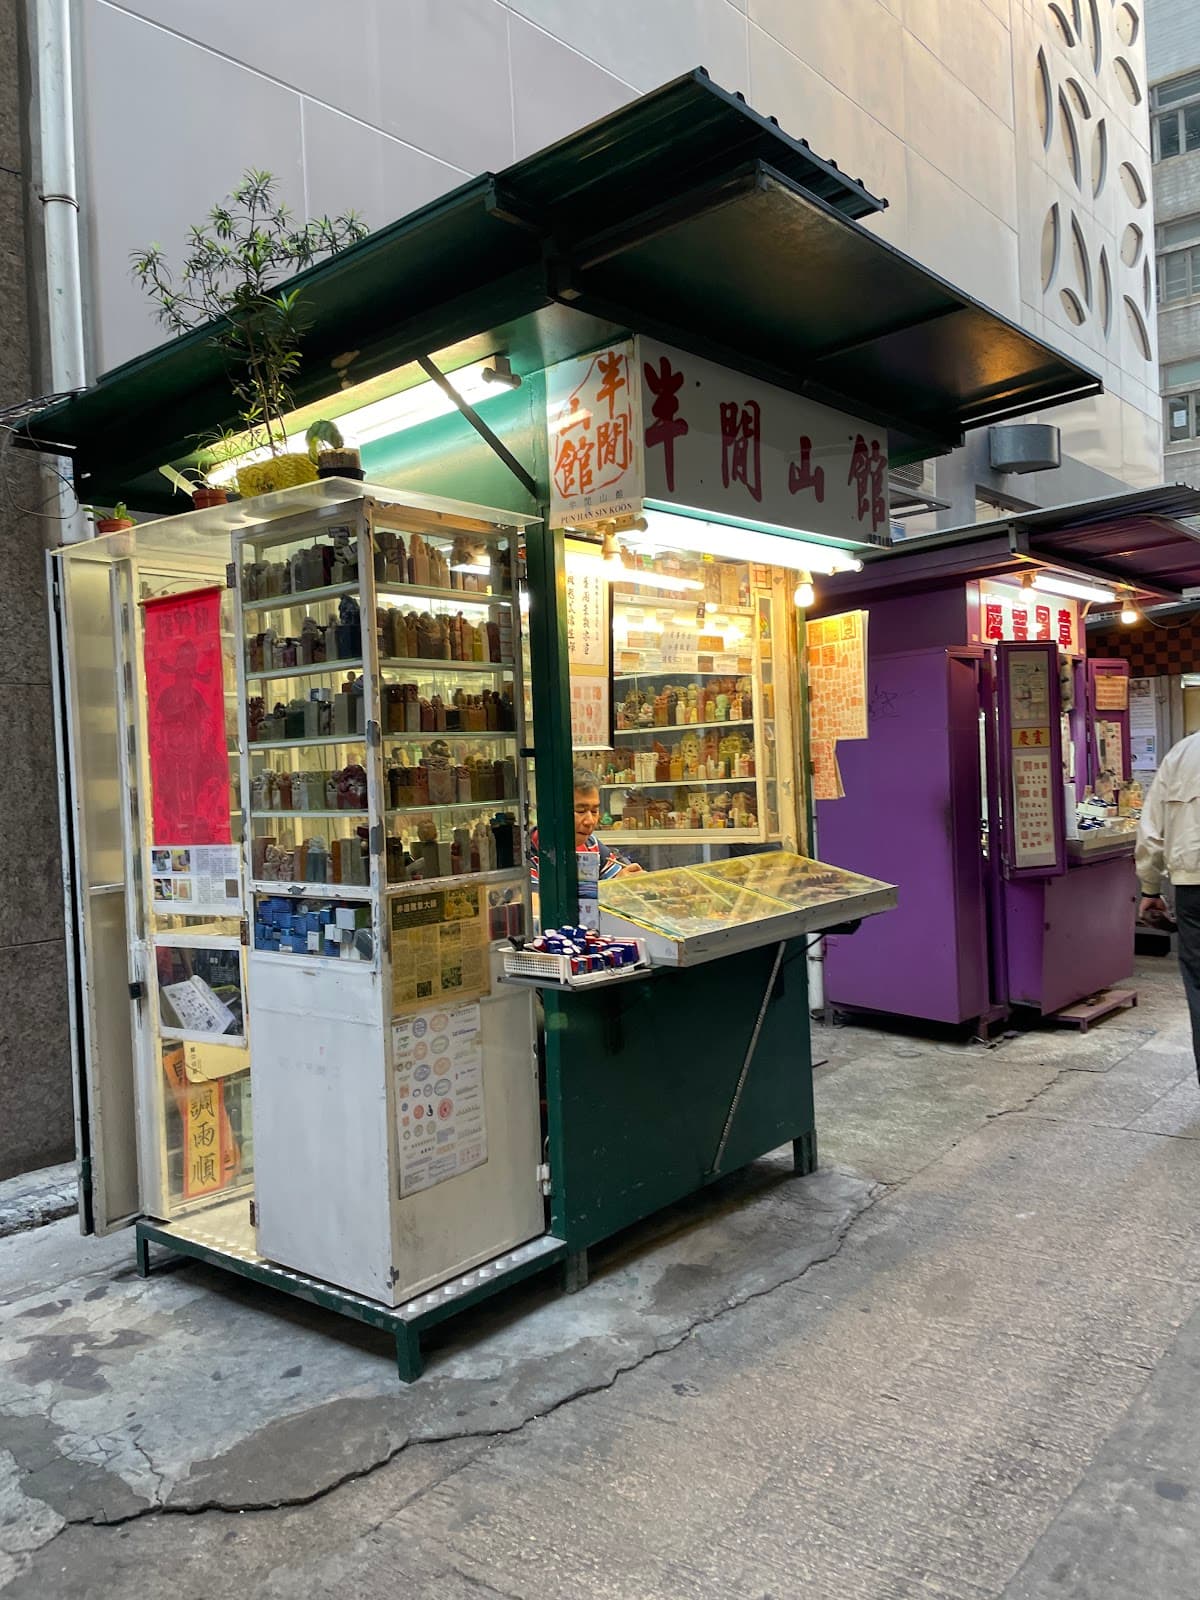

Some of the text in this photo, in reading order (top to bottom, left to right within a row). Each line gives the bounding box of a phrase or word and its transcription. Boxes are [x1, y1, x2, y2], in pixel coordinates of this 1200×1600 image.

[561, 513, 576, 524] PUN
[577, 511, 593, 521] HAN
[609, 503, 632, 514] KOON
